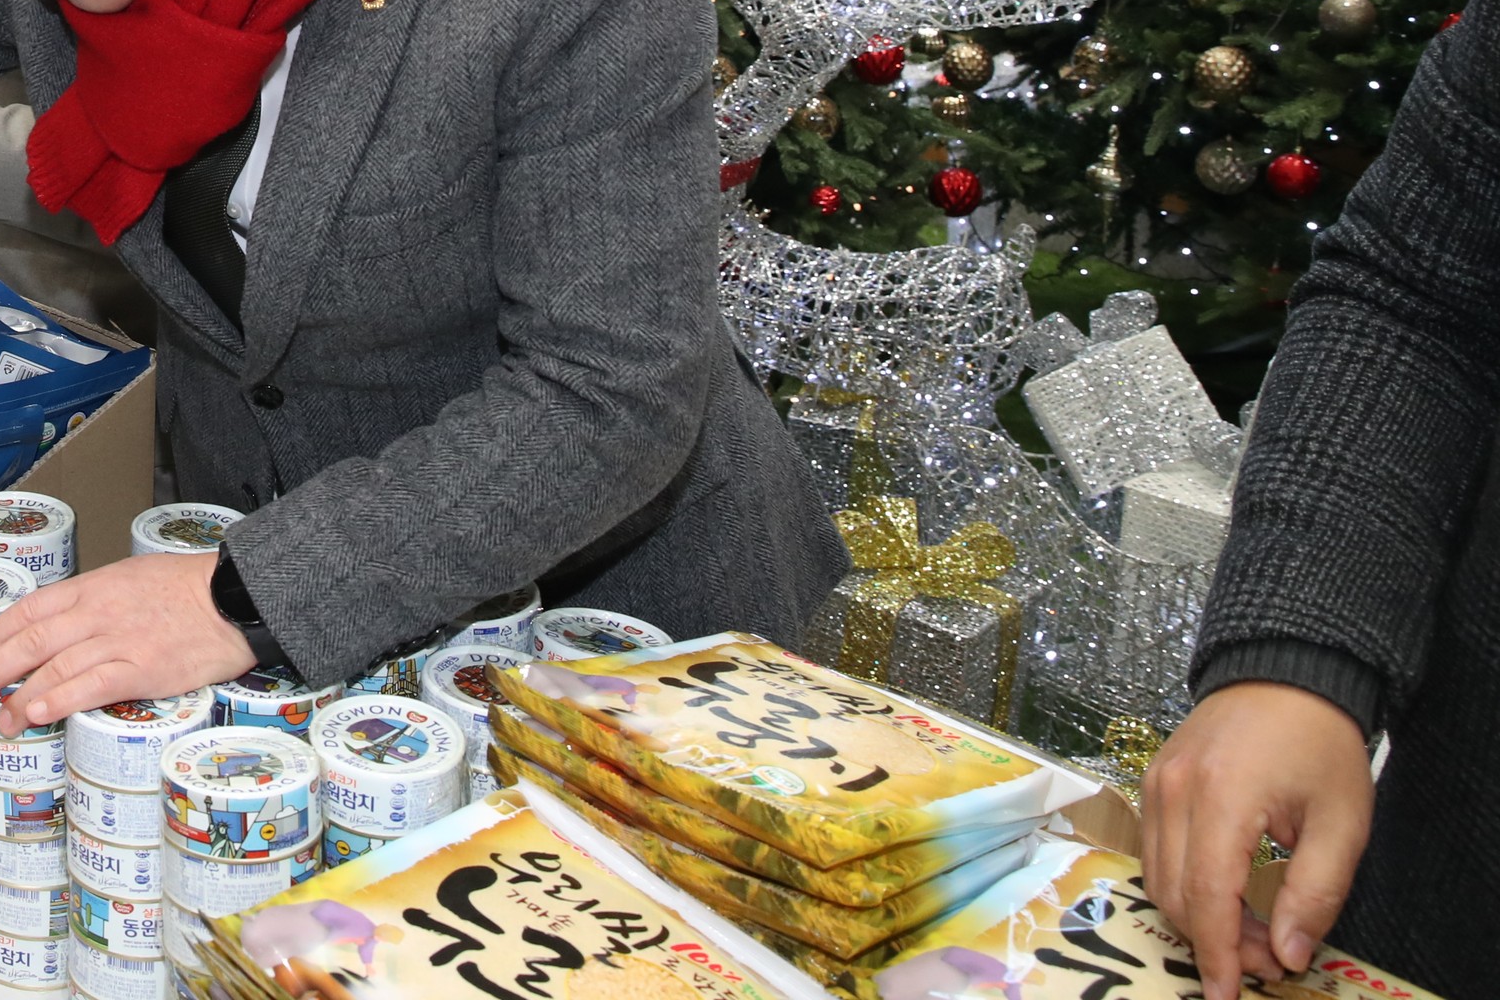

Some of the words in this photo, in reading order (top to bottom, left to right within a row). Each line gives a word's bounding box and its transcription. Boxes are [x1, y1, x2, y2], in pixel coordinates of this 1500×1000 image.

[322, 705, 402, 748] DONGWON
[426, 721, 452, 753] TUNA
[894, 715, 961, 742] 100%
[176, 739, 222, 761] TUNA
[71, 836, 120, 875] 동원참치
[506, 889, 576, 933] 가마솥
[1132, 918, 1195, 960] 가마
[670, 943, 743, 983] 100%
[1321, 960, 1413, 998] 100%
